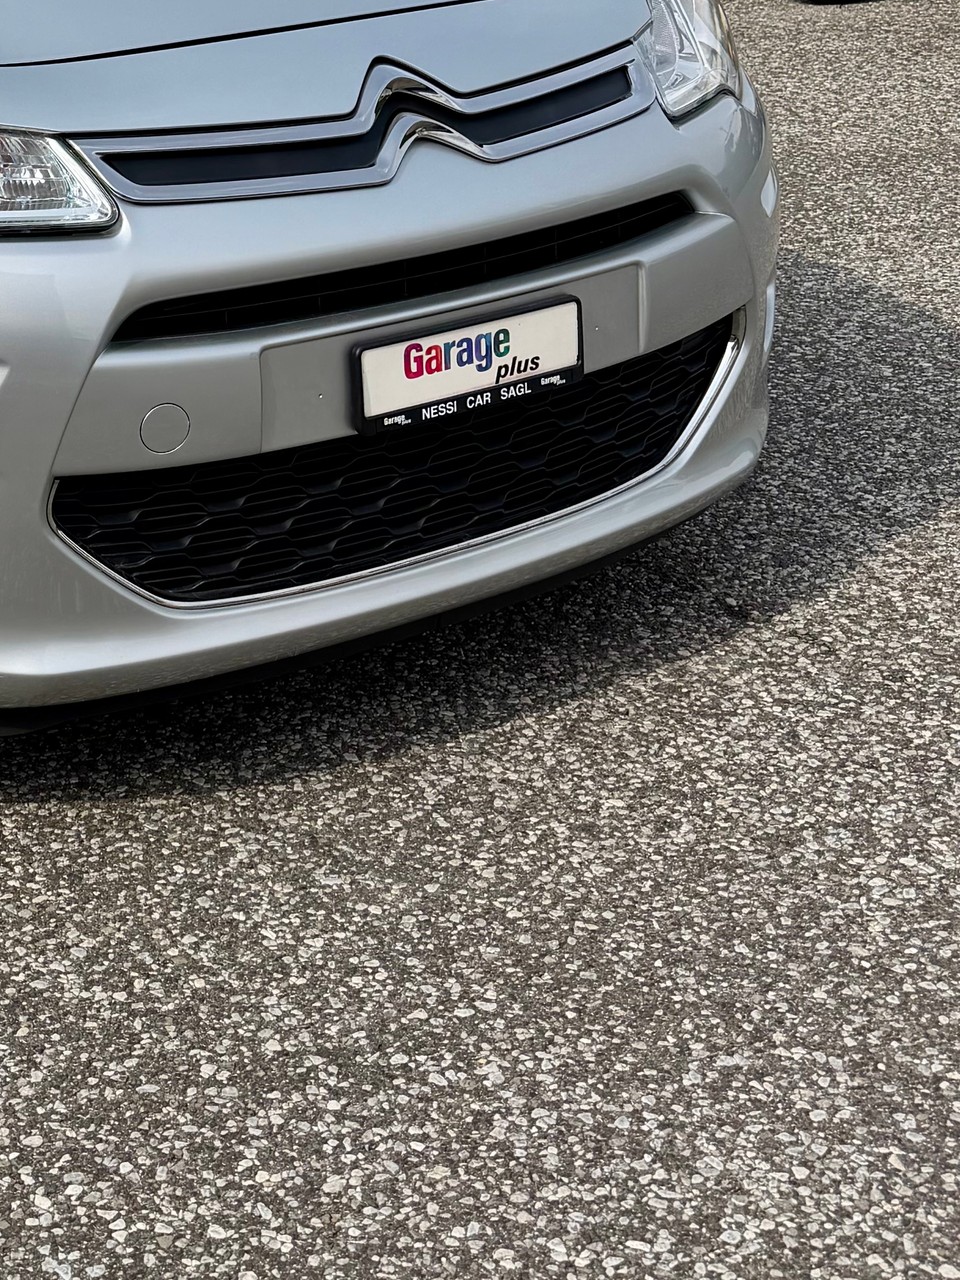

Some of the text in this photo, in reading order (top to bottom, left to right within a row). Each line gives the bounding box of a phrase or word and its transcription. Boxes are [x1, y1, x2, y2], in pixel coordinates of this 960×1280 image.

[403, 328, 510, 380] Garage
[494, 355, 540, 384] plus
[540, 374, 561, 386] Garage
[421, 382, 532, 421] NESSI CAR SAGL
[383, 414, 406, 426] Garage
